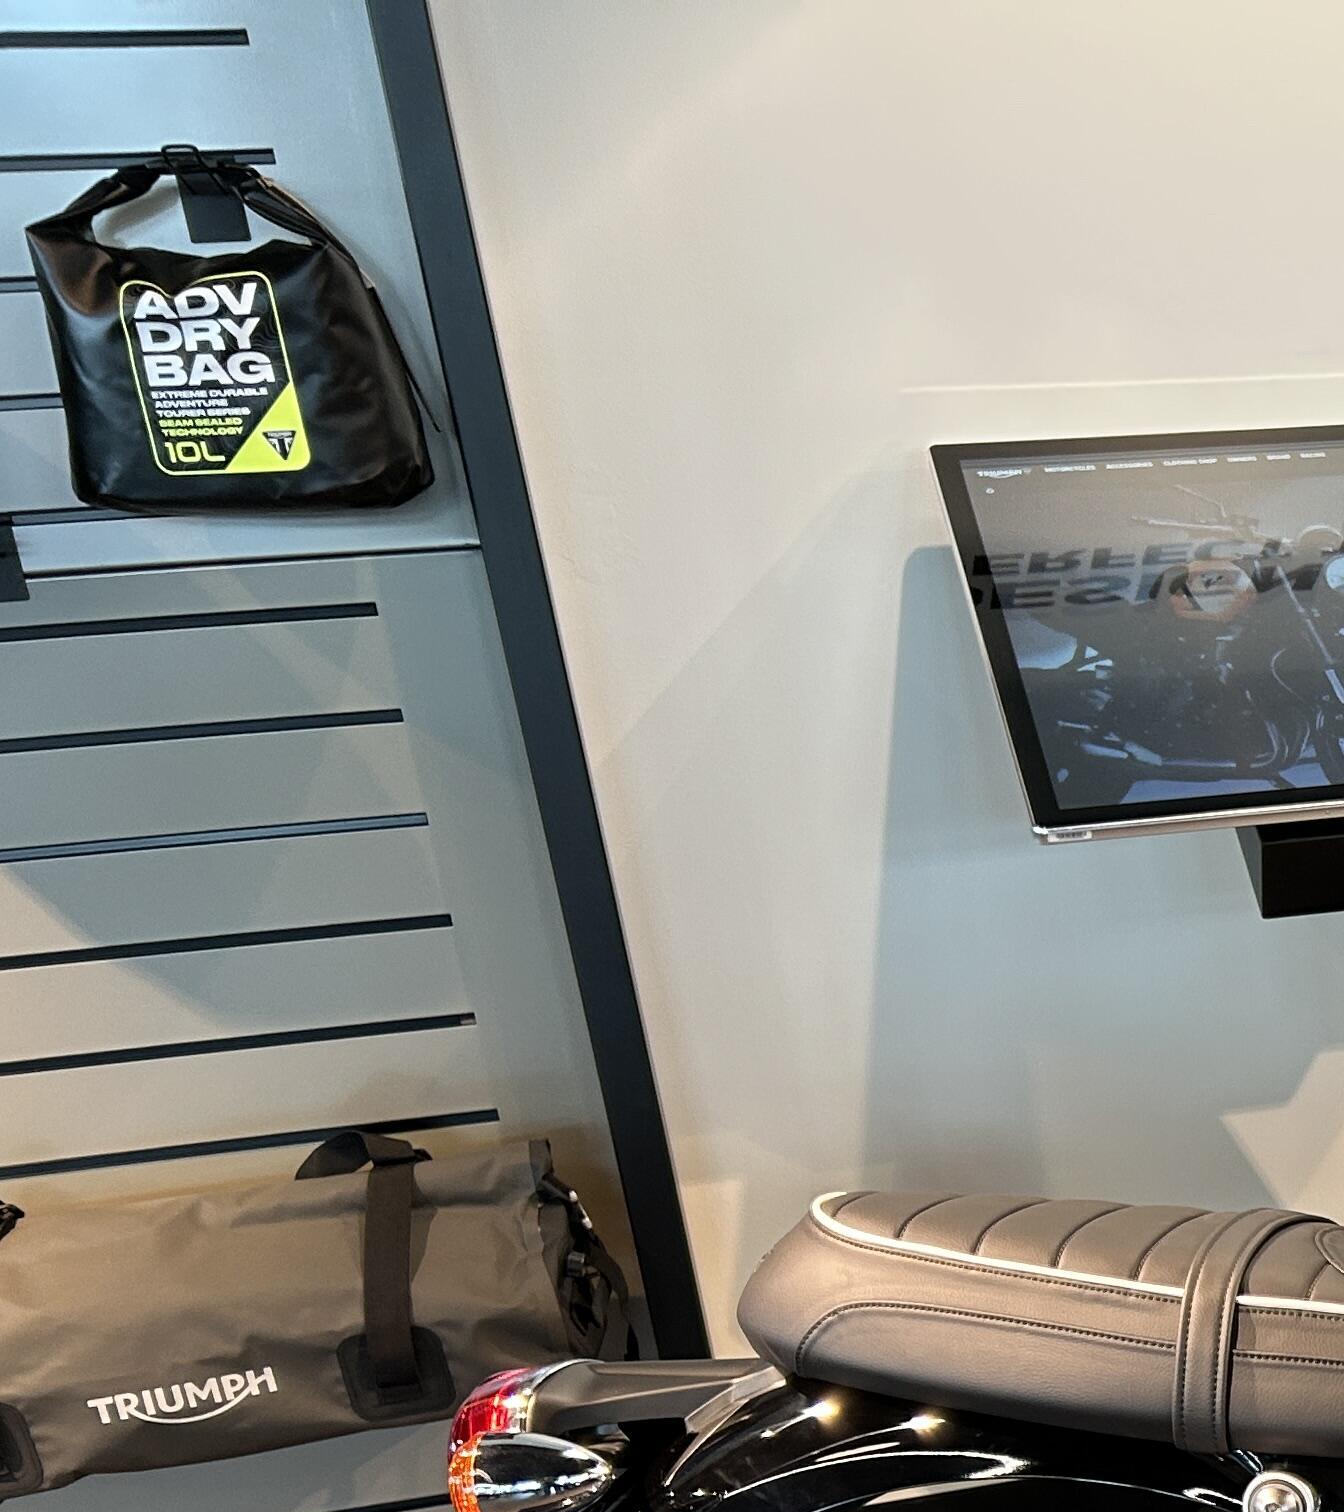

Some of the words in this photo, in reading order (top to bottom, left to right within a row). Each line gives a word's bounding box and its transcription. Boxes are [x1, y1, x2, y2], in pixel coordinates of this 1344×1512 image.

[134, 282, 257, 319] ADV
[135, 317, 260, 353] DRY
[143, 351, 275, 387] BAG
[151, 389, 208, 399] EXTREME
[209, 387, 268, 398] DURABLE
[155, 399, 228, 408] ADVENTURE
[156, 408, 205, 418] TOURER
[159, 418, 194, 427] SEAM
[195, 417, 243, 427] SEALED
[162, 426, 243, 437] TECHNOLOGY
[165, 441, 226, 464] 10L
[87, 1366, 278, 1424] TRIUMPH
